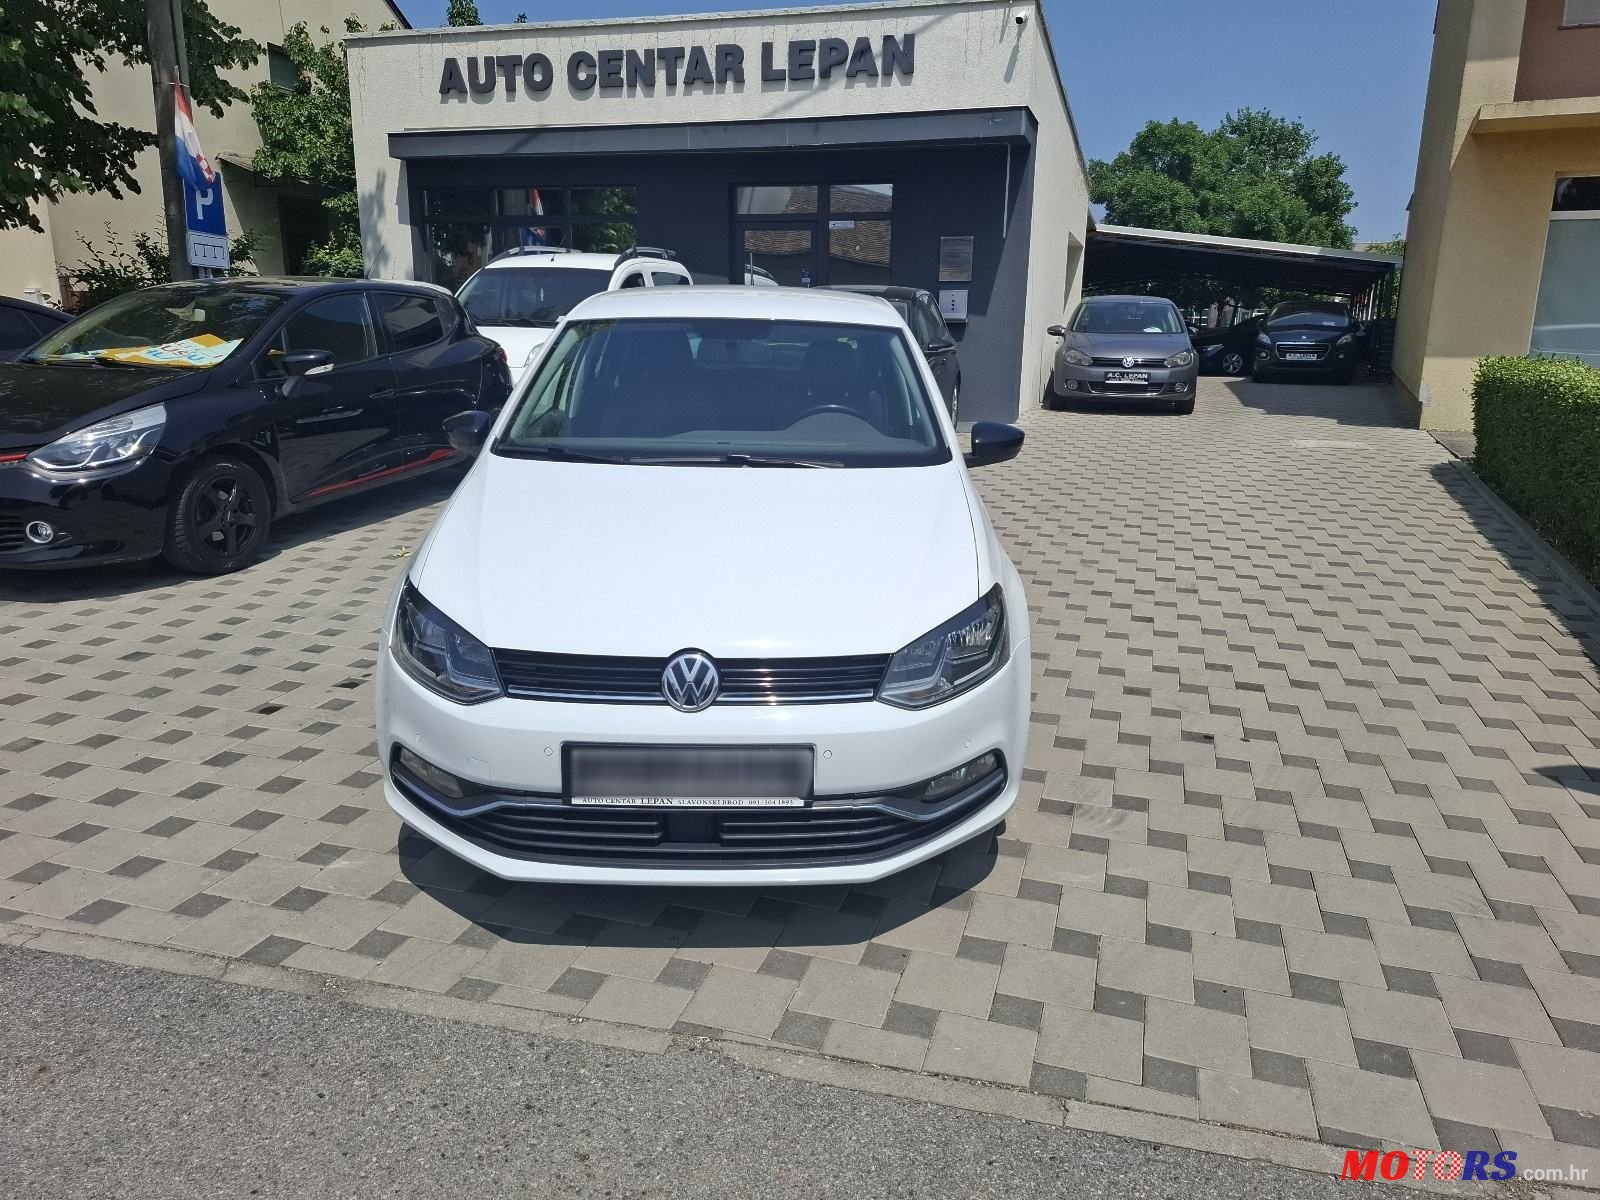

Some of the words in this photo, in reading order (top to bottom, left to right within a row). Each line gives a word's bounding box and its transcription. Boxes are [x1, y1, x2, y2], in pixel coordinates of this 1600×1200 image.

[439, 52, 553, 94] AUTO
[567, 46, 745, 90] CENTAR
[761, 33, 915, 82] LEPAN
[195, 188, 213, 220] P
[641, 797, 673, 805] LEPAN
